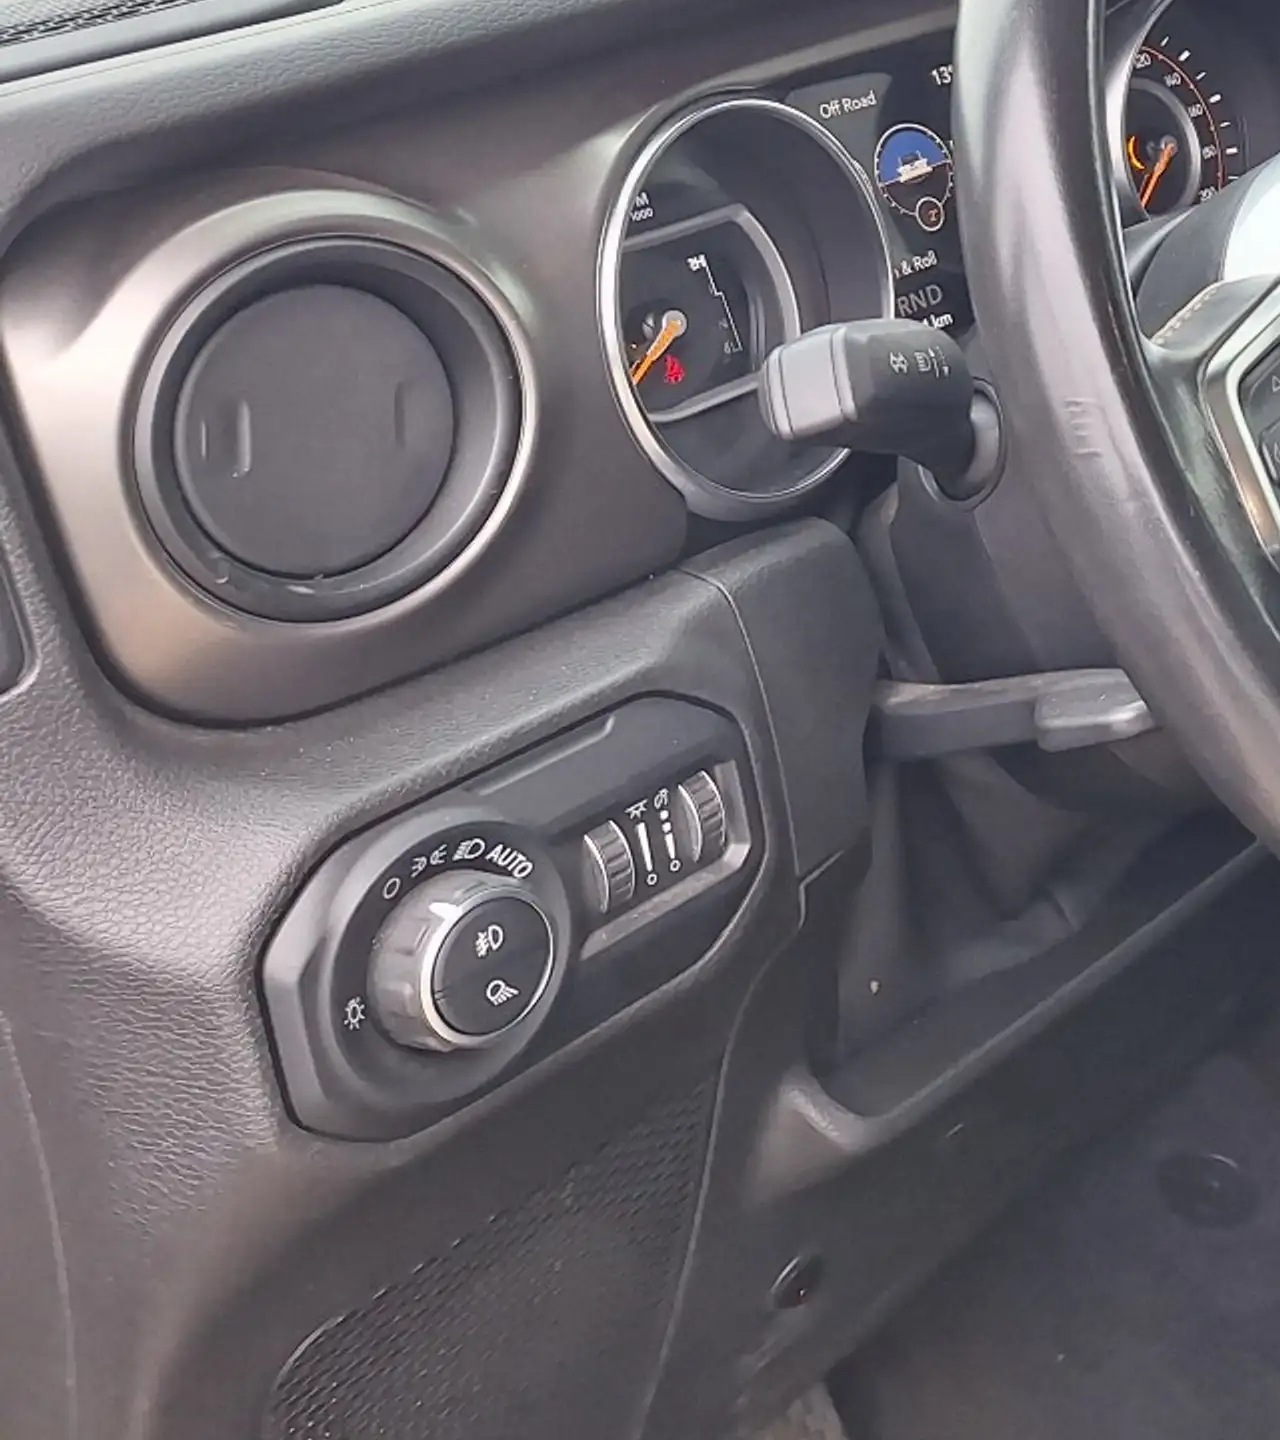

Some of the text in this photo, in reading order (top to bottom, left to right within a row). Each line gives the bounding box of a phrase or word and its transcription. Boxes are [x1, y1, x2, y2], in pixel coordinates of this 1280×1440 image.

[819, 89, 877, 119] Off Road
[484, 843, 534, 879] AUTO
